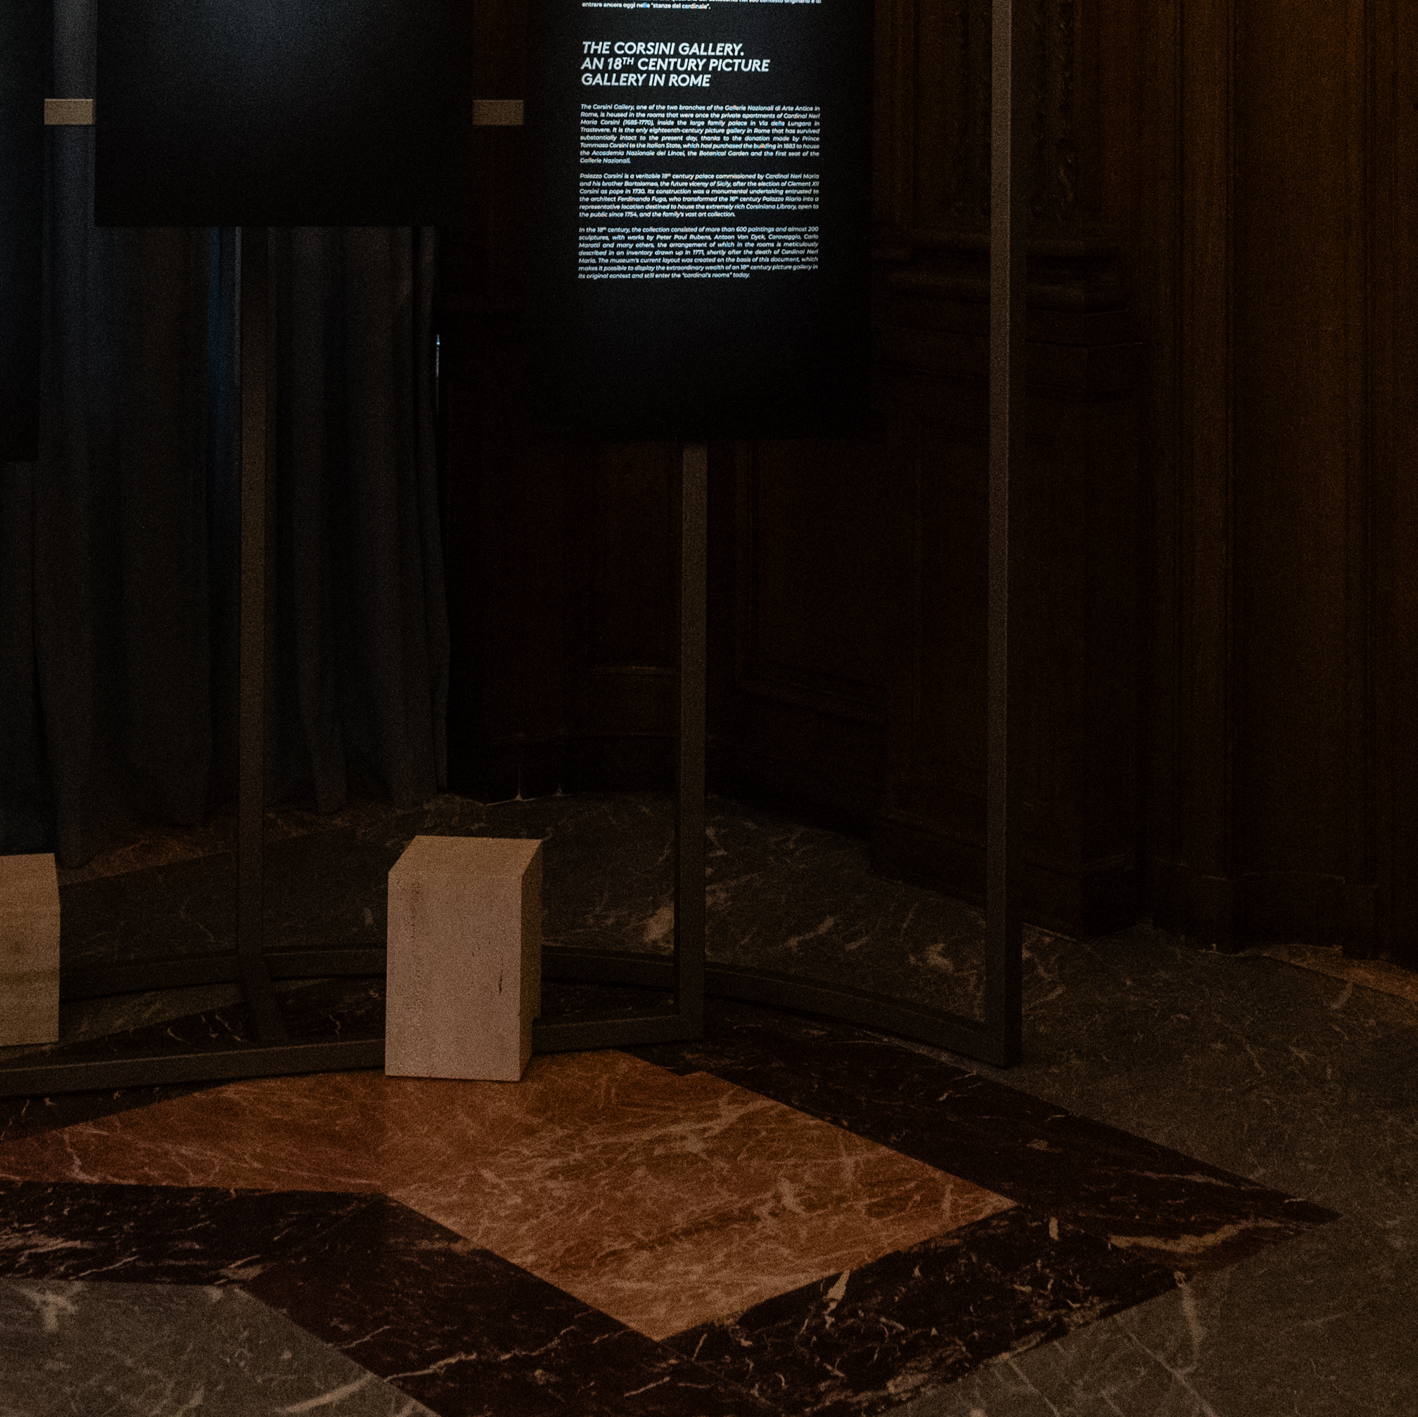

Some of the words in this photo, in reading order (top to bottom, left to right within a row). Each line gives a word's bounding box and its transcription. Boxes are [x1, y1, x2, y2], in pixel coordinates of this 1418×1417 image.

[582, 40, 611, 54] THE
[613, 41, 675, 55] CORSINI
[678, 42, 744, 56] GALLERY.
[580, 56, 604, 69] AN
[607, 56, 634, 70] 18TH
[637, 57, 706, 71] CENTURY
[708, 58, 770, 72] PICTURE
[581, 72, 647, 86] GALLERY
[648, 73, 665, 86] IN
[668, 73, 711, 87] ROME
